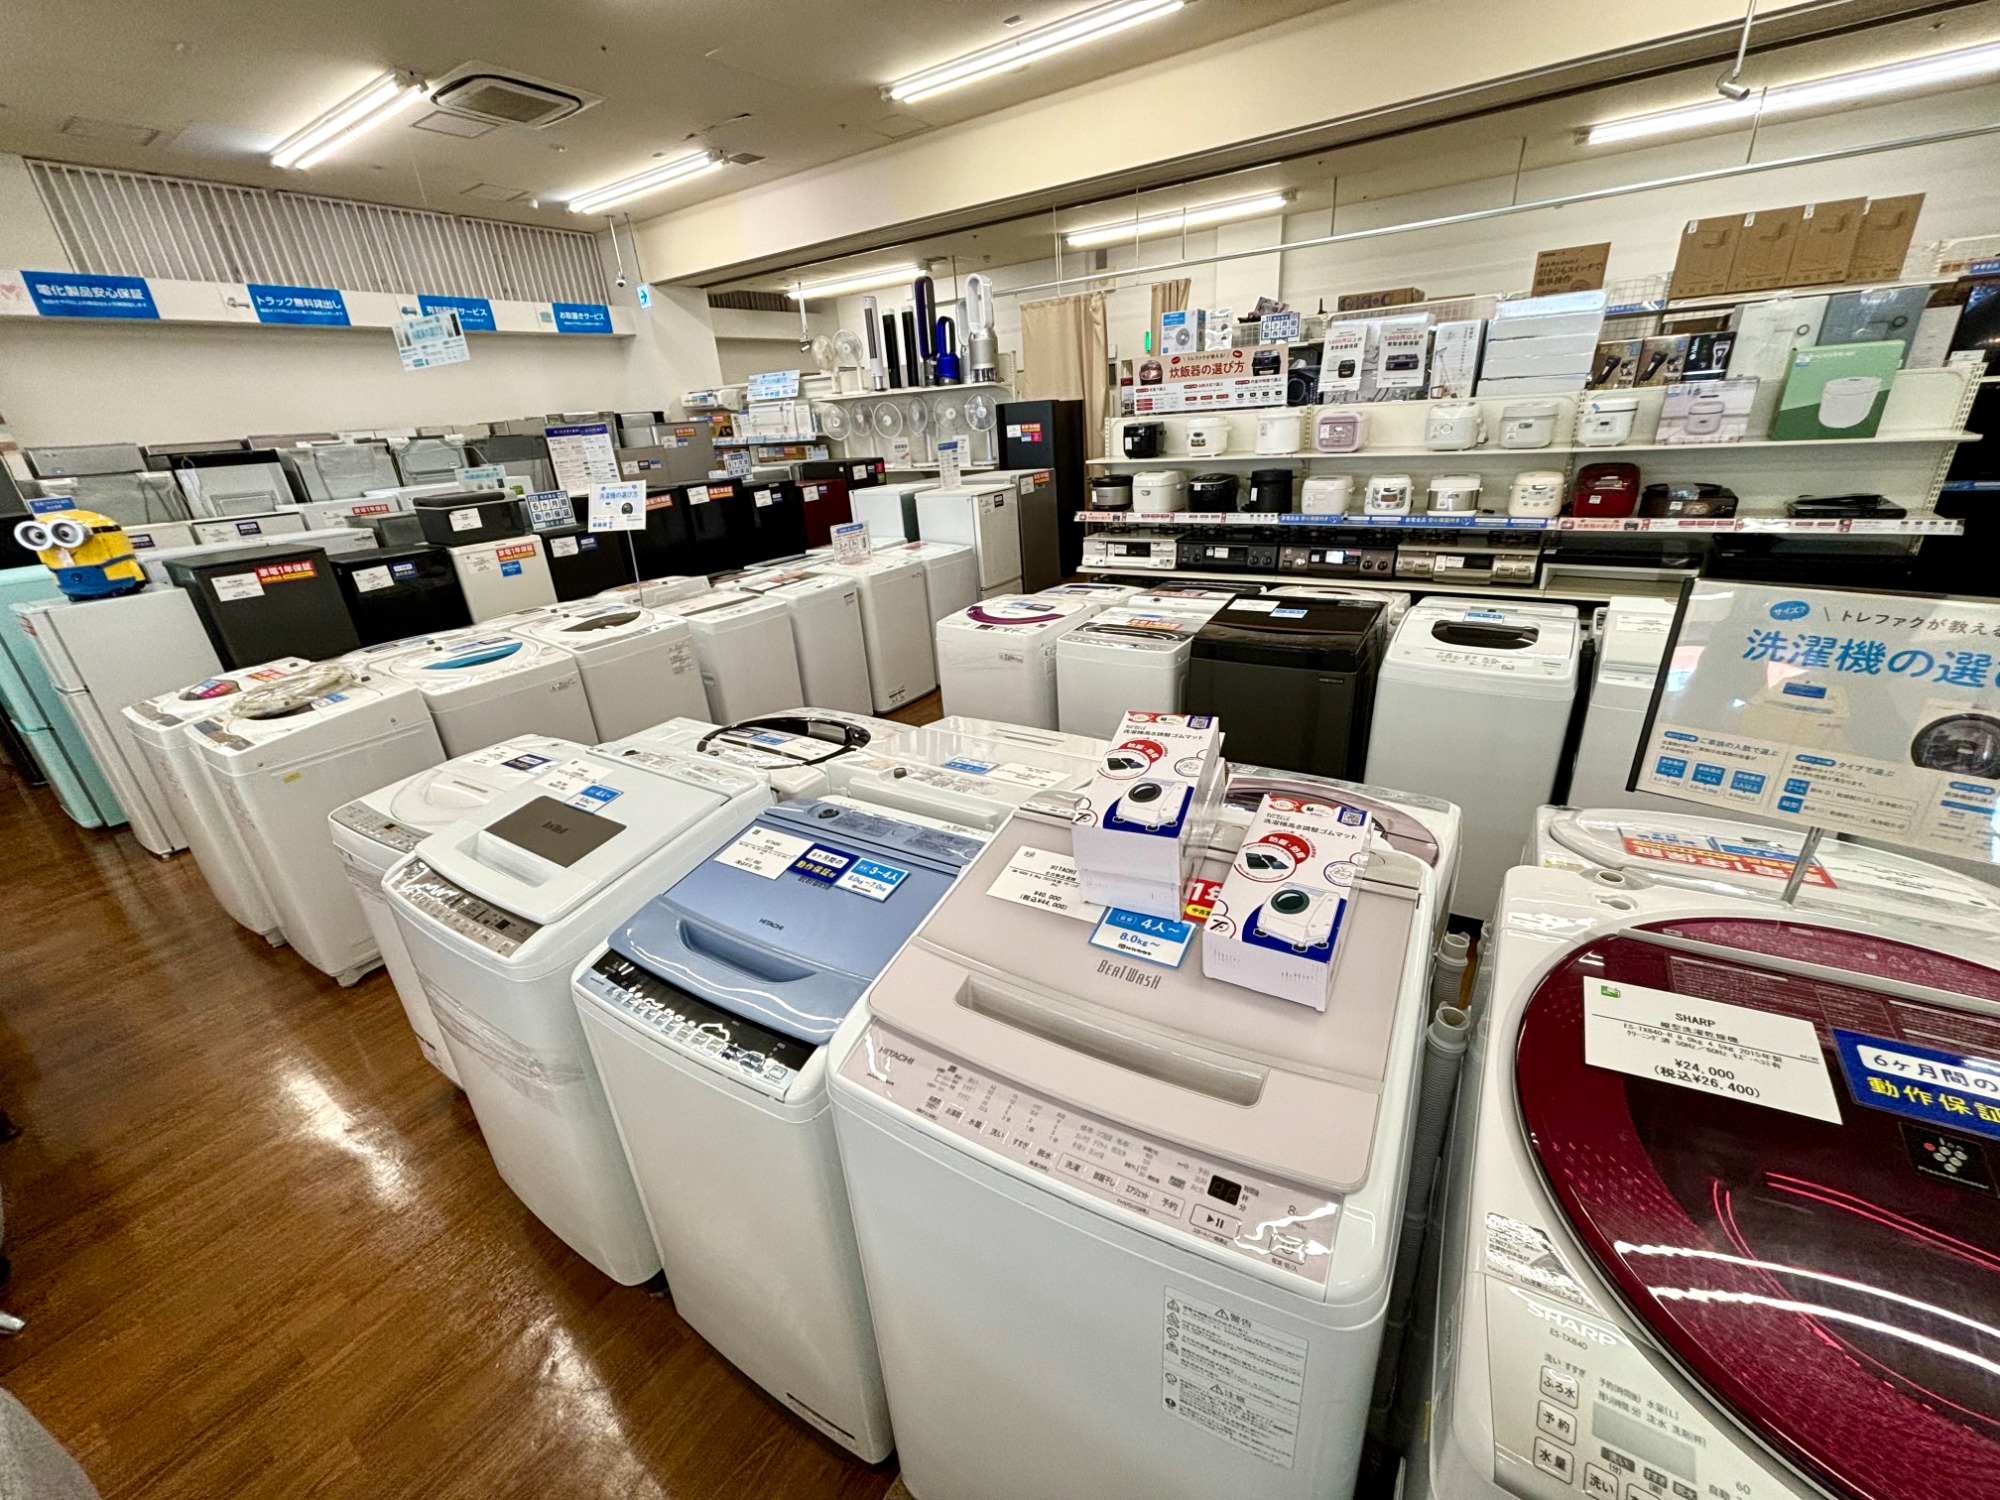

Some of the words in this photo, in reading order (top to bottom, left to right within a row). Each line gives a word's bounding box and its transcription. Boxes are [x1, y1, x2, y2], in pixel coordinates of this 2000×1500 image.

[256, 295, 341, 309] トラック無料貸出し
[1170, 360, 1245, 378] 炊飯器の選び方
[258, 563, 311, 577] 家電1年保証
[1743, 629, 2000, 688] 洗濯機の選
[1123, 729, 1204, 740] 洗濯機高さ調整ゴムマット
[1700, 737, 1779, 757] ご家族の人数で選ぶ
[1838, 762, 1896, 778] タイプで選ぶ
[1263, 818, 1357, 840] 洗濯機高さ調整ゴムマット
[1050, 864, 1077, 875] HITACHI
[759, 918, 784, 931] HITACHI
[1675, 1013, 1716, 1028] SHARP
[1660, 1021, 1739, 1044] 縦型洗濯乾燥機
[879, 1046, 915, 1065] HITACHI
[1866, 1076, 2000, 1124] 動作保証
[968, 1118, 983, 1129] 水量
[990, 1128, 1004, 1139] 洗い
[1013, 1138, 1029, 1150] すすぎ
[1036, 1149, 1052, 1160] 脱水
[1064, 1159, 1081, 1172] 洗濯
[1093, 1171, 1115, 1187] 部屋干し
[1161, 1197, 1179, 1212] 予約
[1527, 1302, 1617, 1346] SHARP
[1549, 1327, 1588, 1350] ES-TX840
[1543, 1376, 1576, 1399] ふろ水
[1543, 1411, 1571, 1434] 予約
[1539, 1449, 1567, 1472] 水量
[1589, 1473, 1614, 1494] 洗い
[1735, 1481, 1751, 1495] 60
